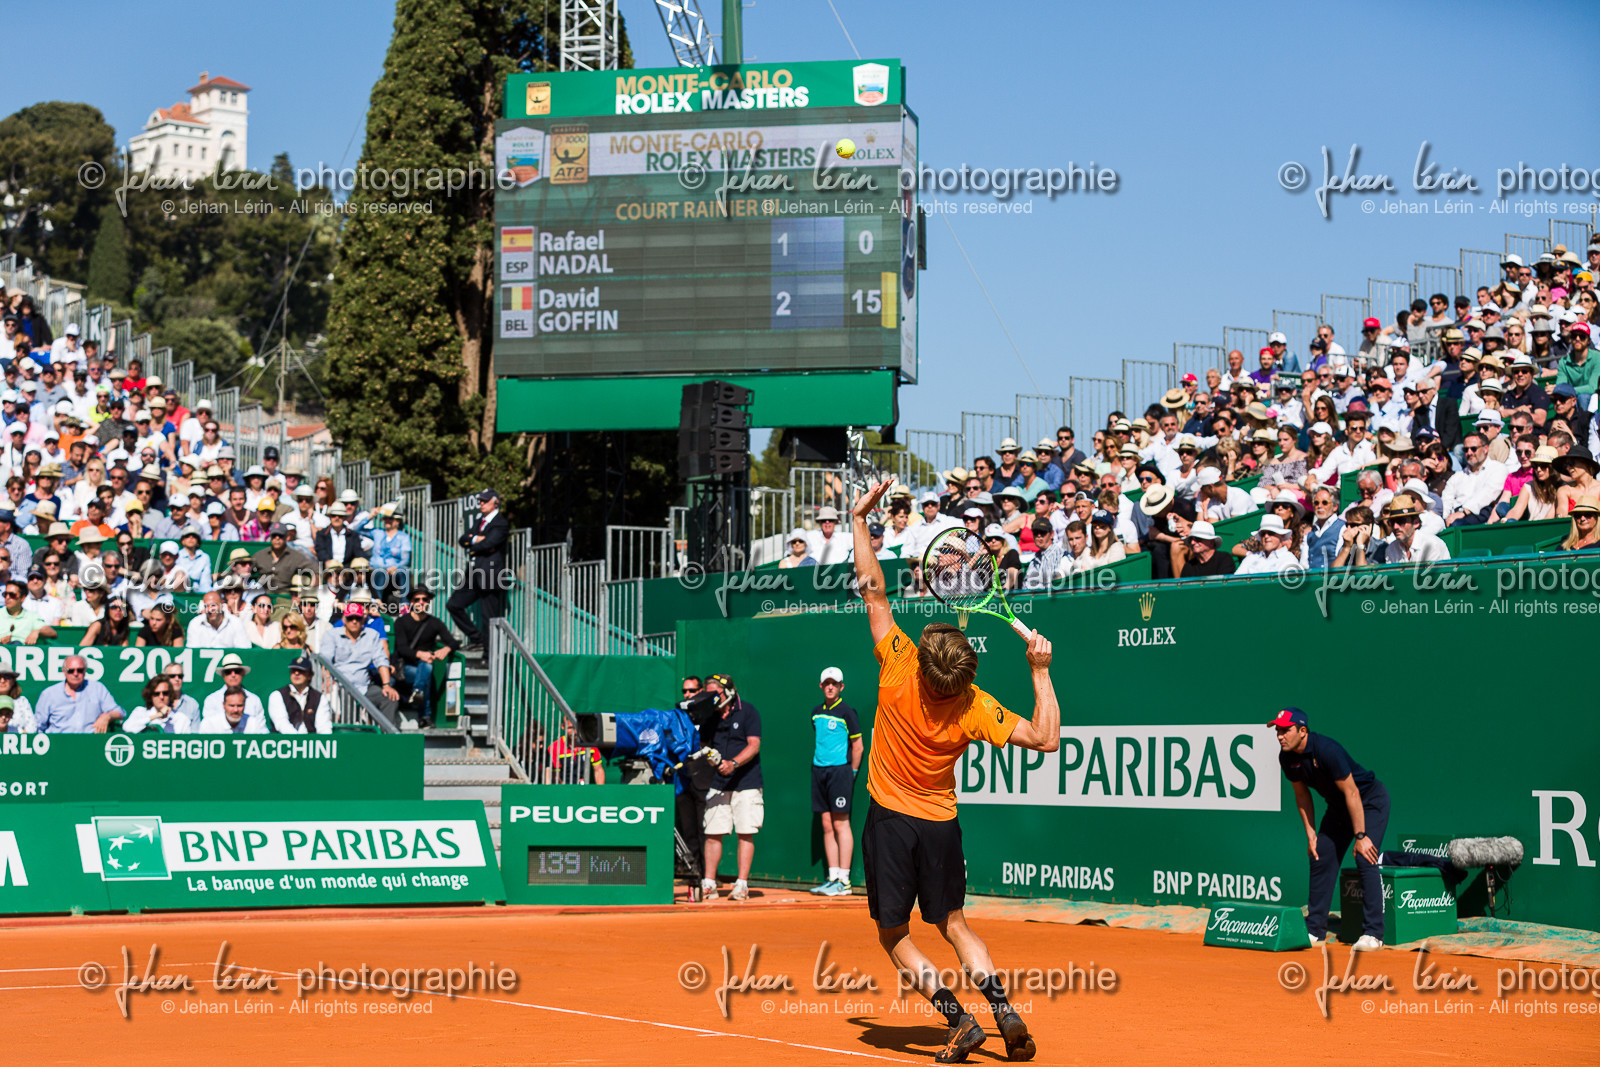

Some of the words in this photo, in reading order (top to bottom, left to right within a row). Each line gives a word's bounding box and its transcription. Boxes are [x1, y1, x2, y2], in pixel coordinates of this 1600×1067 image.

[616, 68, 793, 95] MONTE-CARLO
[616, 91, 693, 115] ROLEX
[702, 86, 809, 111] MASTERS
[610, 130, 764, 155] MONTE-CARLO
[848, 148, 896, 160] OLEX
[646, 150, 713, 172] ROLEX
[720, 147, 815, 169] MASTERS
[554, 167, 585, 177] ATP
[616, 202, 680, 221] COURT
[684, 199, 758, 220] RAINIER
[539, 230, 605, 252] Rafael
[777, 233, 789, 256] 1
[858, 230, 874, 255] 0
[506, 261, 528, 274] ESP
[539, 254, 614, 275] NADAL
[539, 286, 600, 309] David
[776, 291, 791, 316] 2
[851, 289, 882, 314] 15
[506, 318, 528, 332] BEL
[538, 310, 618, 333] GOFFIN
[1117, 626, 1177, 648] ROLEX
[0, 646, 104, 682] RES
[119, 648, 225, 683] 2017
[0, 733, 50, 755] RLO
[143, 740, 226, 760] SERGIO
[233, 740, 338, 759] TACCHINI
[961, 740, 1046, 794] BNP
[1058, 734, 1257, 800] PARIBAS
[510, 805, 665, 824] PEUGEOT
[179, 830, 268, 863] BNP
[282, 827, 461, 861] PARIBAS
[538, 852, 581, 875] 139
[589, 856, 631, 873] Km/h
[187, 877, 208, 892] La
[211, 876, 274, 893] banque
[279, 874, 316, 889] d'un
[321, 873, 377, 889] monde
[381, 873, 407, 891] qui
[411, 872, 469, 890] change
[1002, 862, 1037, 886] BNP
[1040, 864, 1114, 891] PARIBAS
[1153, 869, 1192, 895] BNP
[1197, 872, 1282, 902] PARIBAS
[1398, 890, 1455, 910] Façonnable
[1208, 907, 1279, 937] Façonnable
